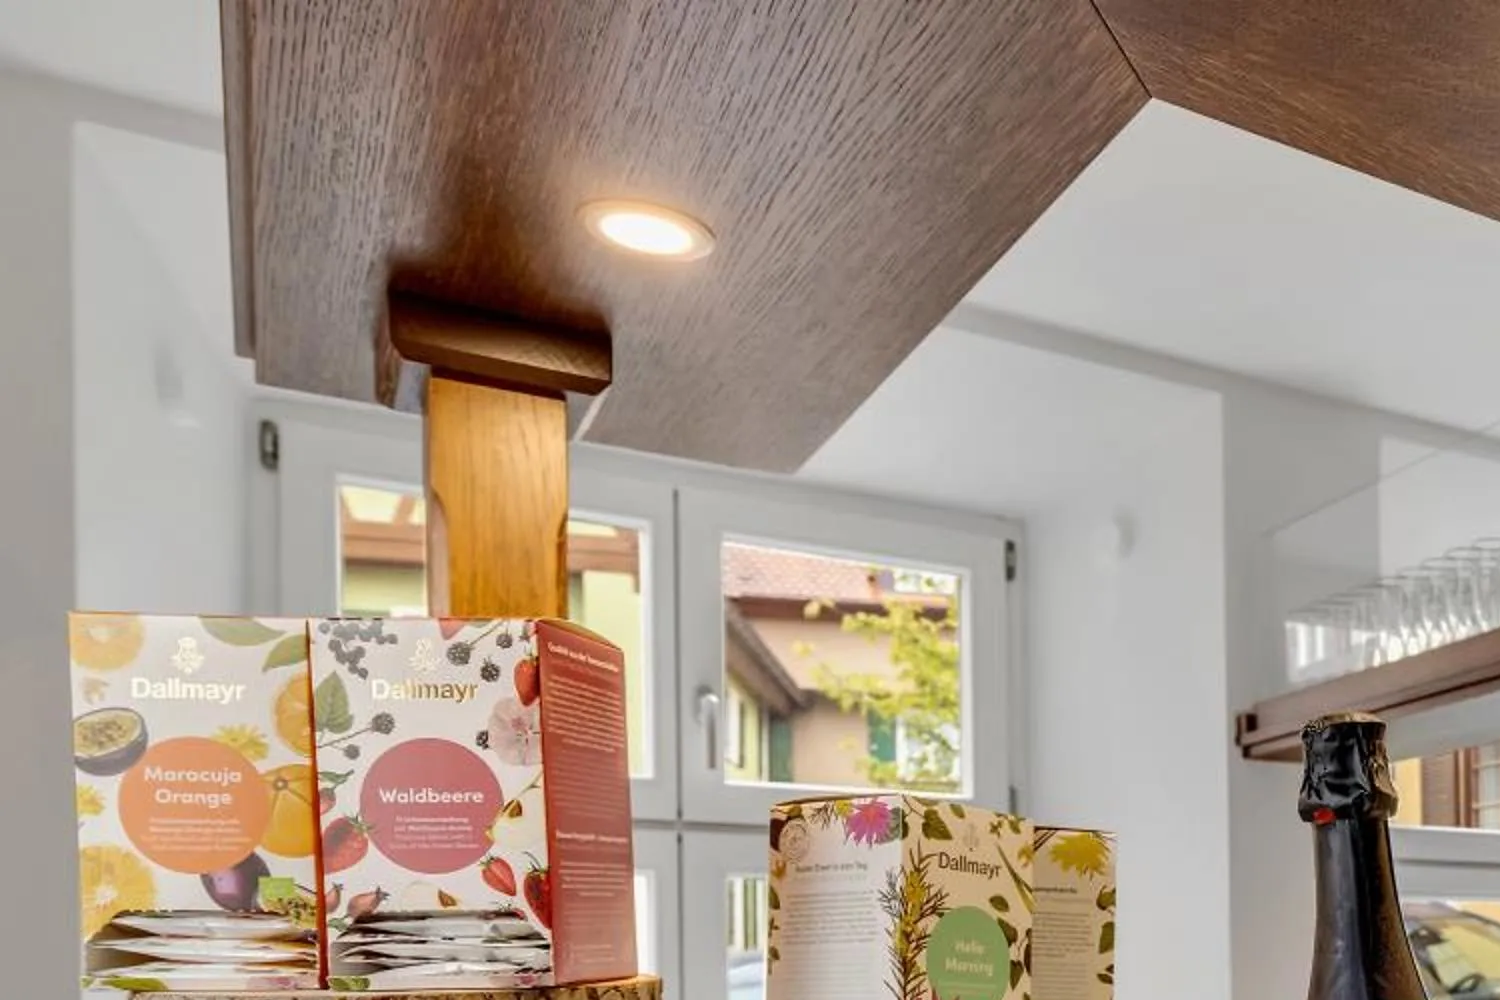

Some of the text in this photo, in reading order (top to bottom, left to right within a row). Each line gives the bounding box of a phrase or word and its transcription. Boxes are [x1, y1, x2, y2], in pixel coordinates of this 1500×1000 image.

[131, 677, 246, 704] Dallmayr
[372, 678, 478, 704] Dallmayr
[144, 766, 242, 787] Maracuja
[155, 788, 233, 808] Orange
[379, 787, 485, 803] Waldbeere
[938, 851, 1001, 879] Dallmayr
